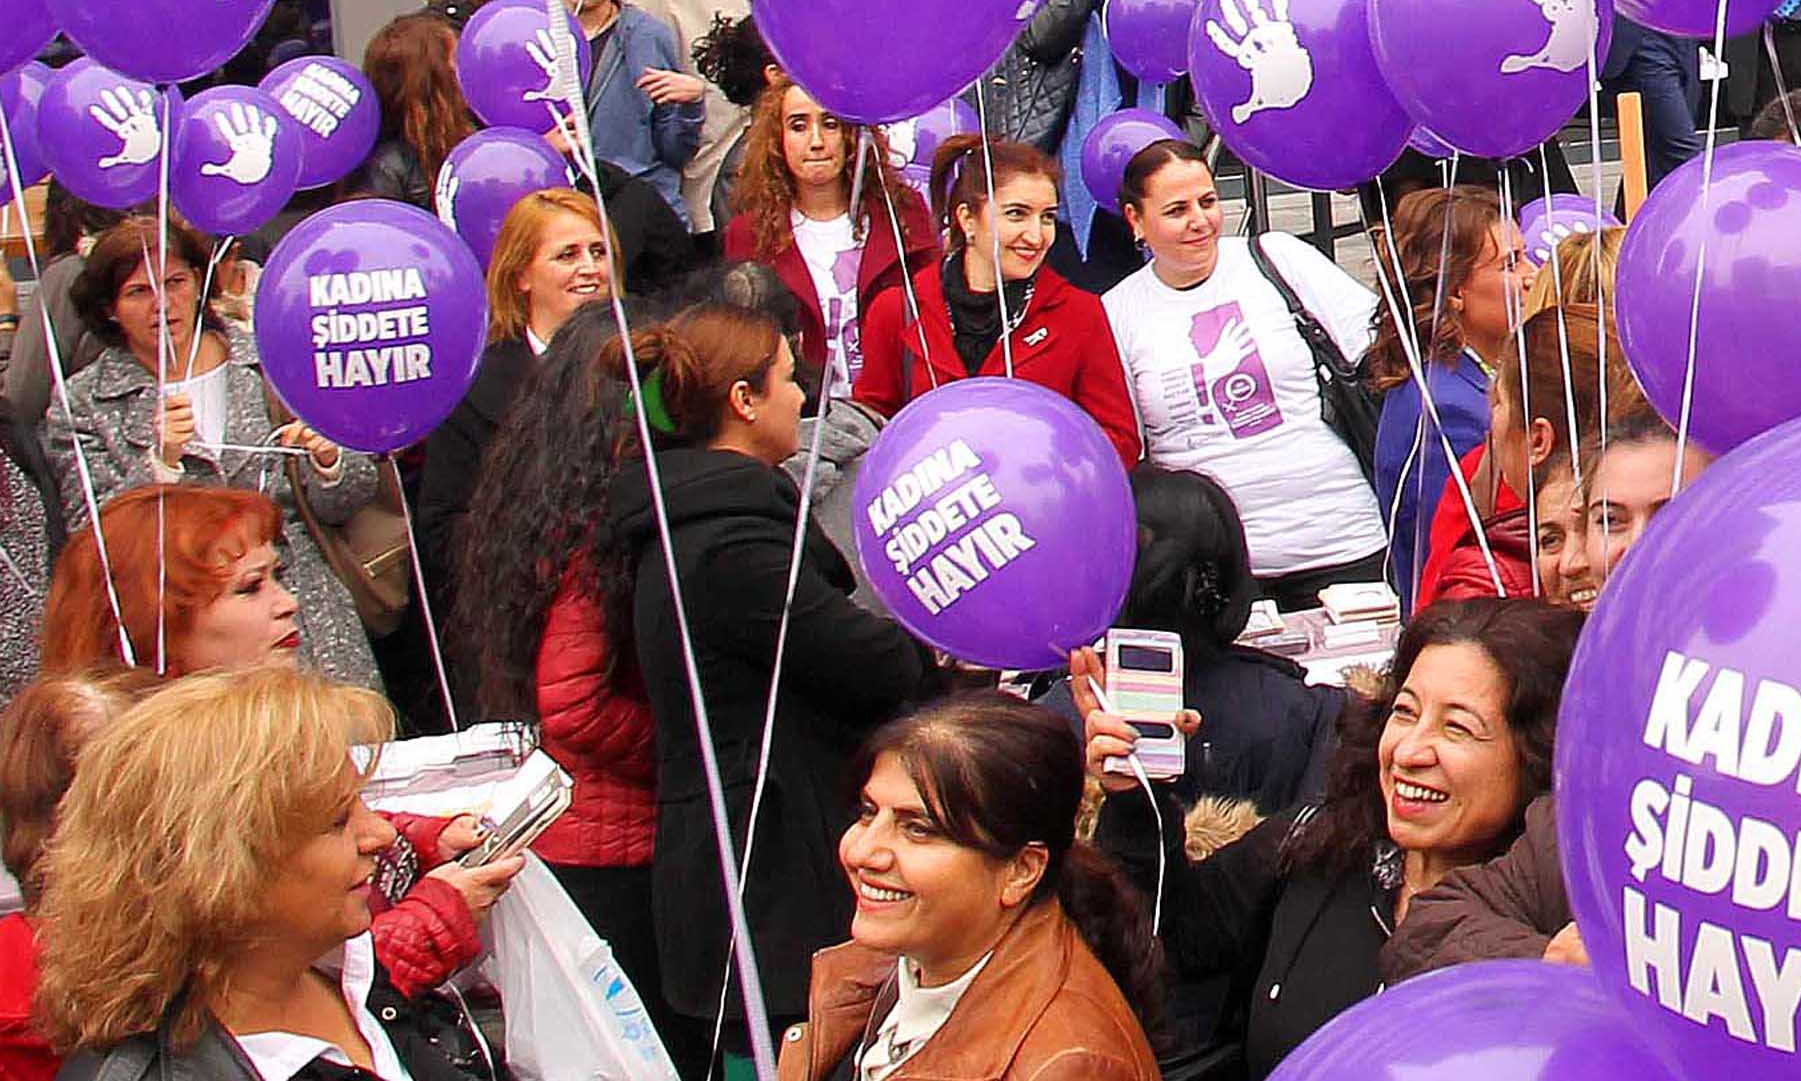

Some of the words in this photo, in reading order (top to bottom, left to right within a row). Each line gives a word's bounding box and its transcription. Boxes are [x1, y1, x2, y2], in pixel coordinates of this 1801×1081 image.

[280, 90, 339, 139] HAYIR
[310, 268, 428, 307] KADINA
[311, 306, 430, 350] ŞİDDETE
[314, 343, 433, 388] HAYIR
[867, 439, 982, 537] KADINA
[886, 473, 1003, 576] ŞİDDETE
[906, 512, 1037, 615] HAYIR
